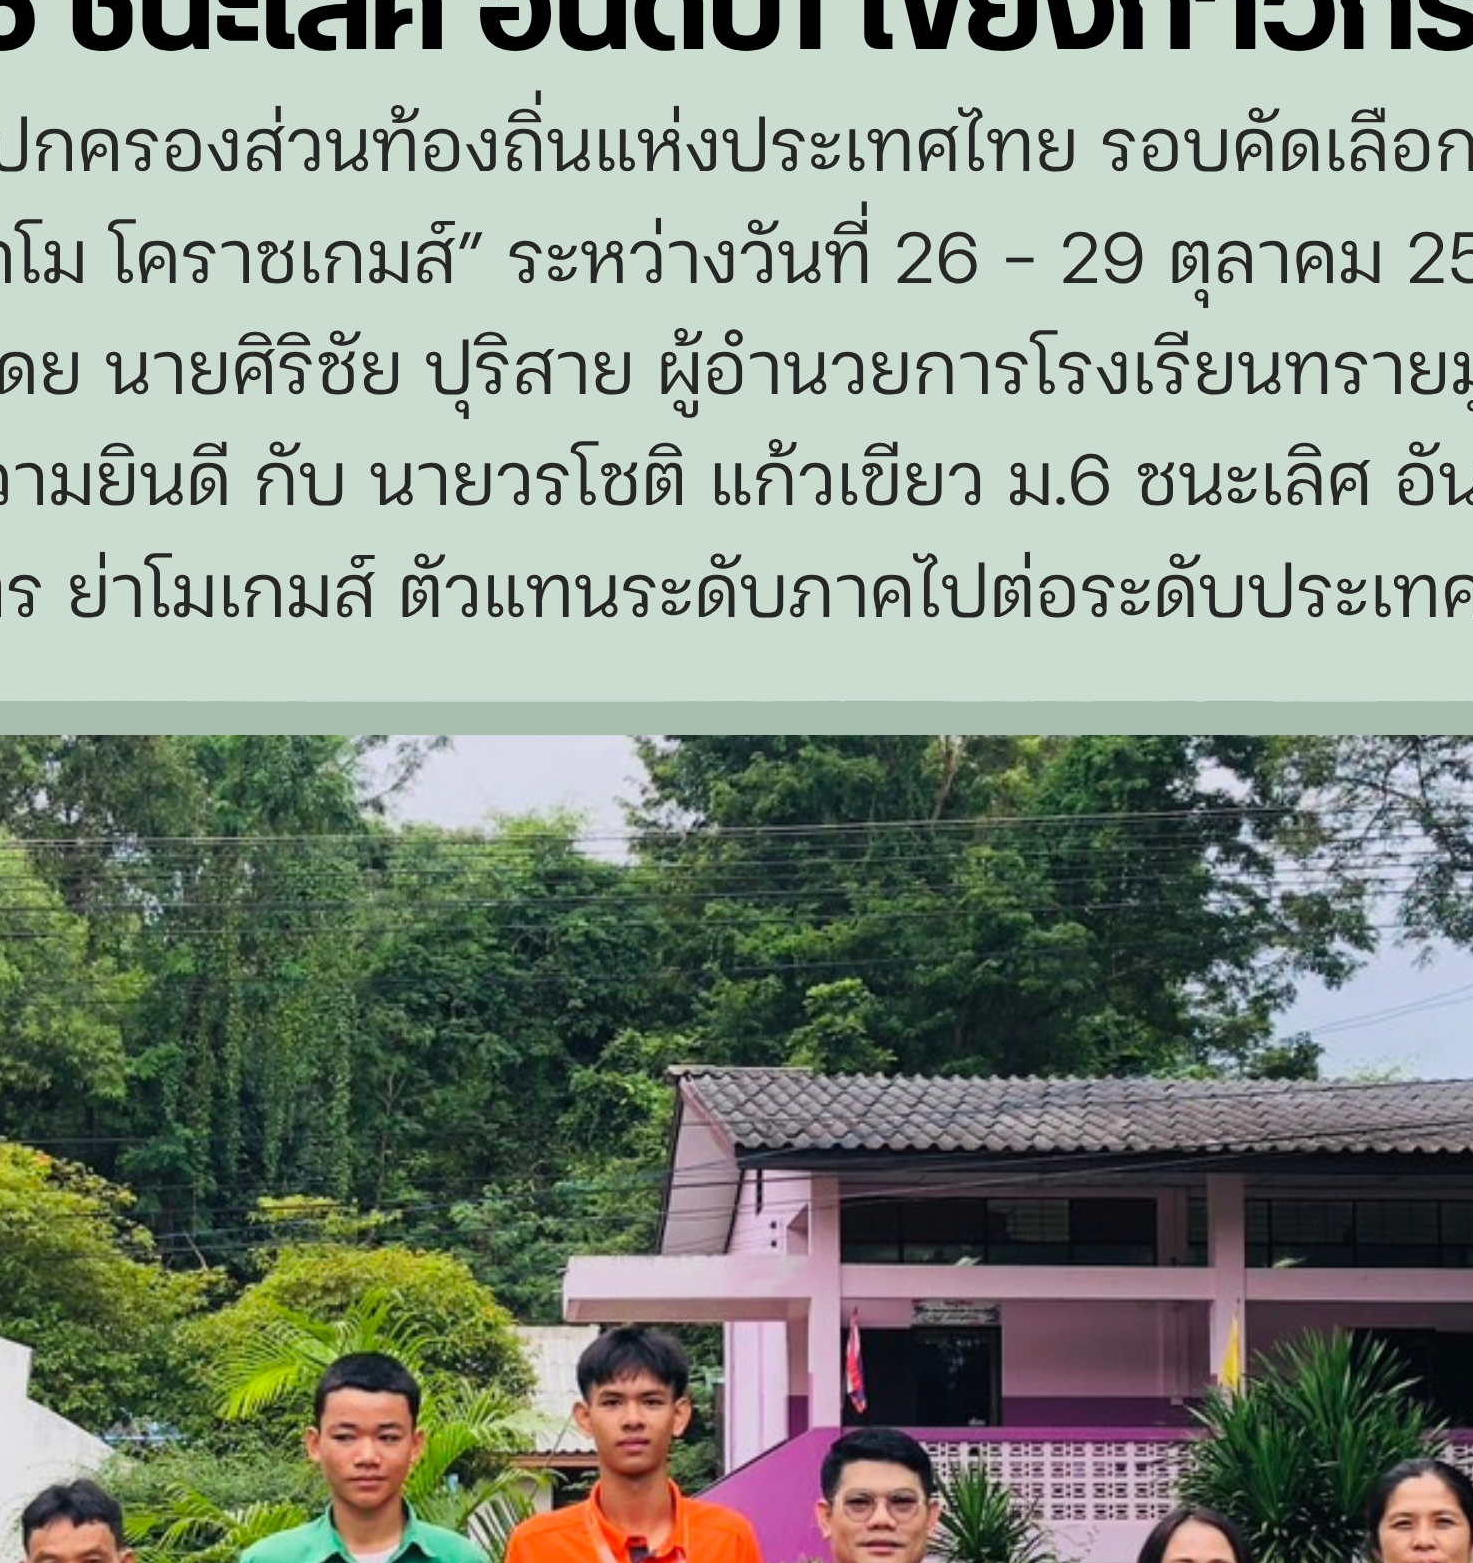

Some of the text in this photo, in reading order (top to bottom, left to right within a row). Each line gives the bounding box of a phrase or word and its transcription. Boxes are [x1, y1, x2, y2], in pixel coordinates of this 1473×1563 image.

[508, 200, 869, 285] ระหว่างวันที่
[896, 230, 979, 285] 26
[1061, 230, 1144, 285] 29
[1171, 239, 1381, 310] ตุลาคม
[104, 329, 400, 396] นายศิริชัย
[424, 330, 632, 421] ปุริสาย
[256, 440, 344, 507] กับ
[369, 439, 684, 507] นายวรโชติ
[713, 437, 982, 507] แก้วเขียว
[1008, 452, 1111, 507] ม.6
[1136, 441, 1372, 507] ชนะเลิศ
[68, 550, 377, 619] ย่าโมเกมส์
